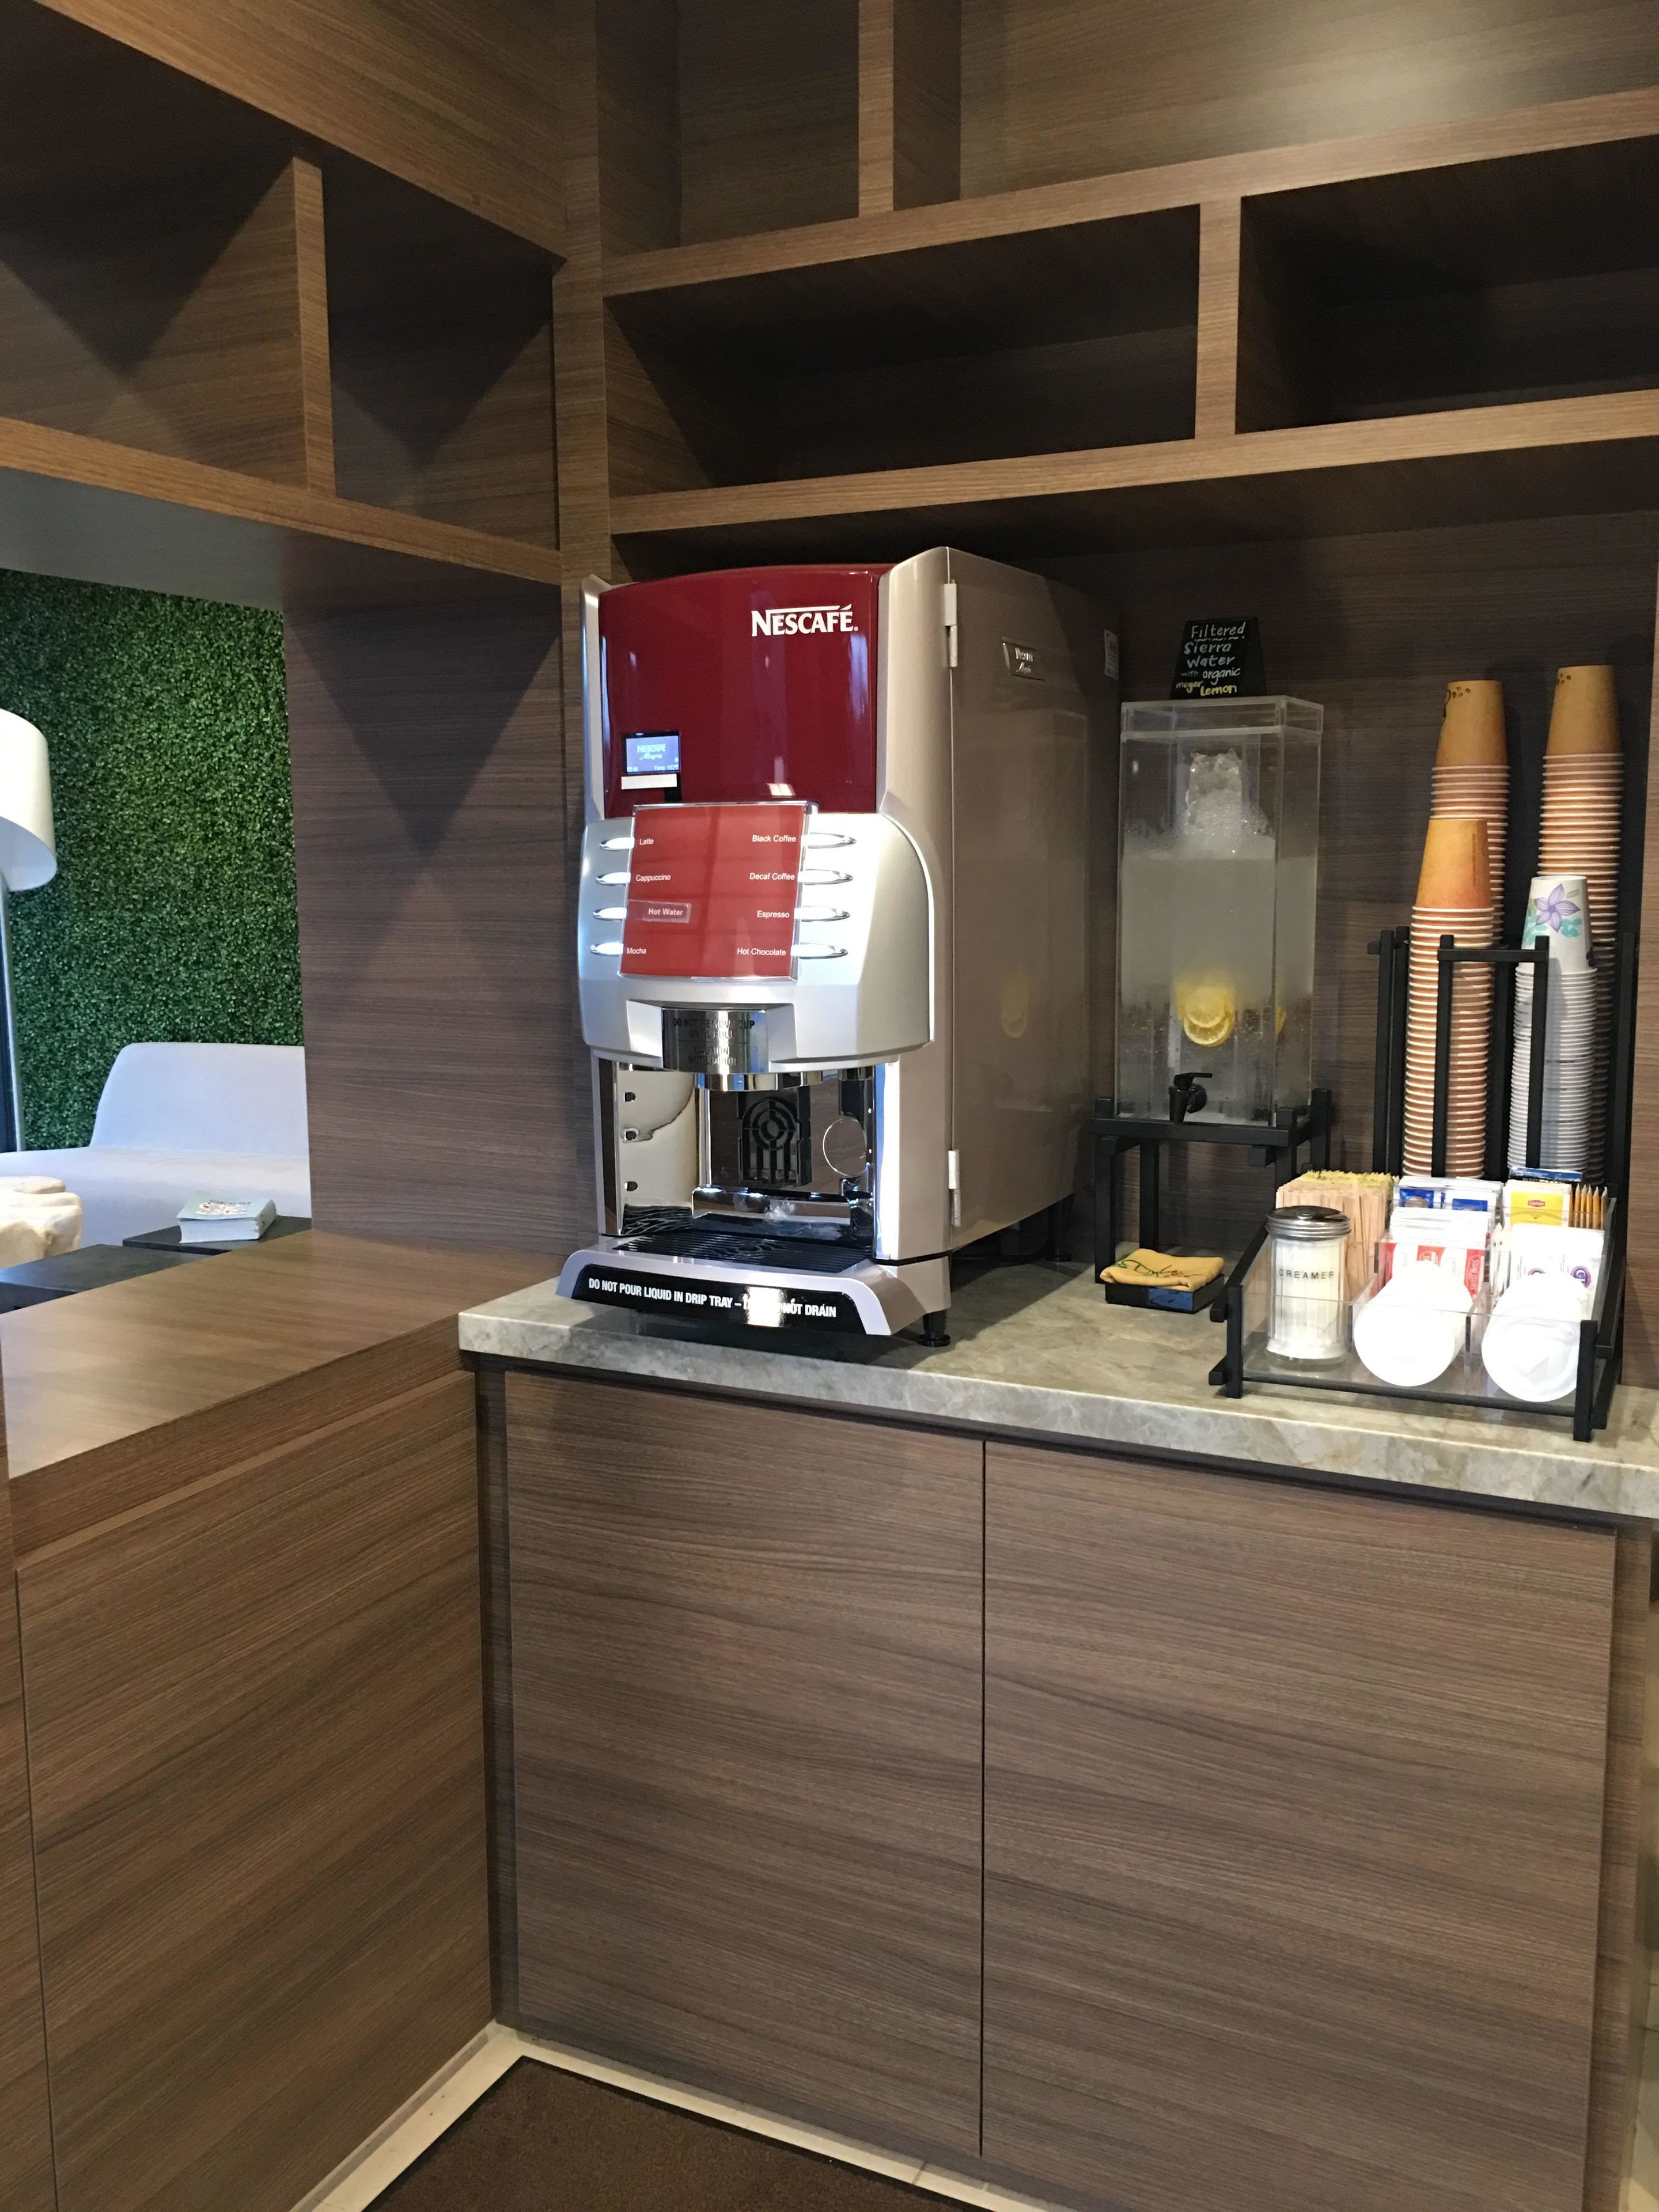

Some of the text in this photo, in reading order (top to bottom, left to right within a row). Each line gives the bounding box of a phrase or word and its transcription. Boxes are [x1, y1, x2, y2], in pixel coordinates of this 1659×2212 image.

[751, 604, 854, 637] NESCAFÉ
[1191, 621, 1246, 638] Filtered
[1184, 642, 1232, 654] Sierra
[1202, 668, 1241, 685] organic
[635, 874, 671, 882] Cappuccino
[749, 872, 771, 880] Decaf
[662, 908, 684, 916] Water
[756, 910, 790, 919] Espresso
[751, 948, 787, 956] Chocolate
[738, 1020, 755, 1029] CUP
[1279, 1268, 1334, 1279] CREAMER
[589, 1278, 600, 1290] DO
[601, 1279, 618, 1293] NOT
[619, 1282, 642, 1297] POUR
[643, 1286, 672, 1301] LIQUID
[673, 1290, 684, 1302] IN
[685, 1293, 707, 1305] DRIP
[709, 1295, 733, 1308] TRAY
[782, 1302, 803, 1315] NOT
[805, 1304, 837, 1317] DRAIN
